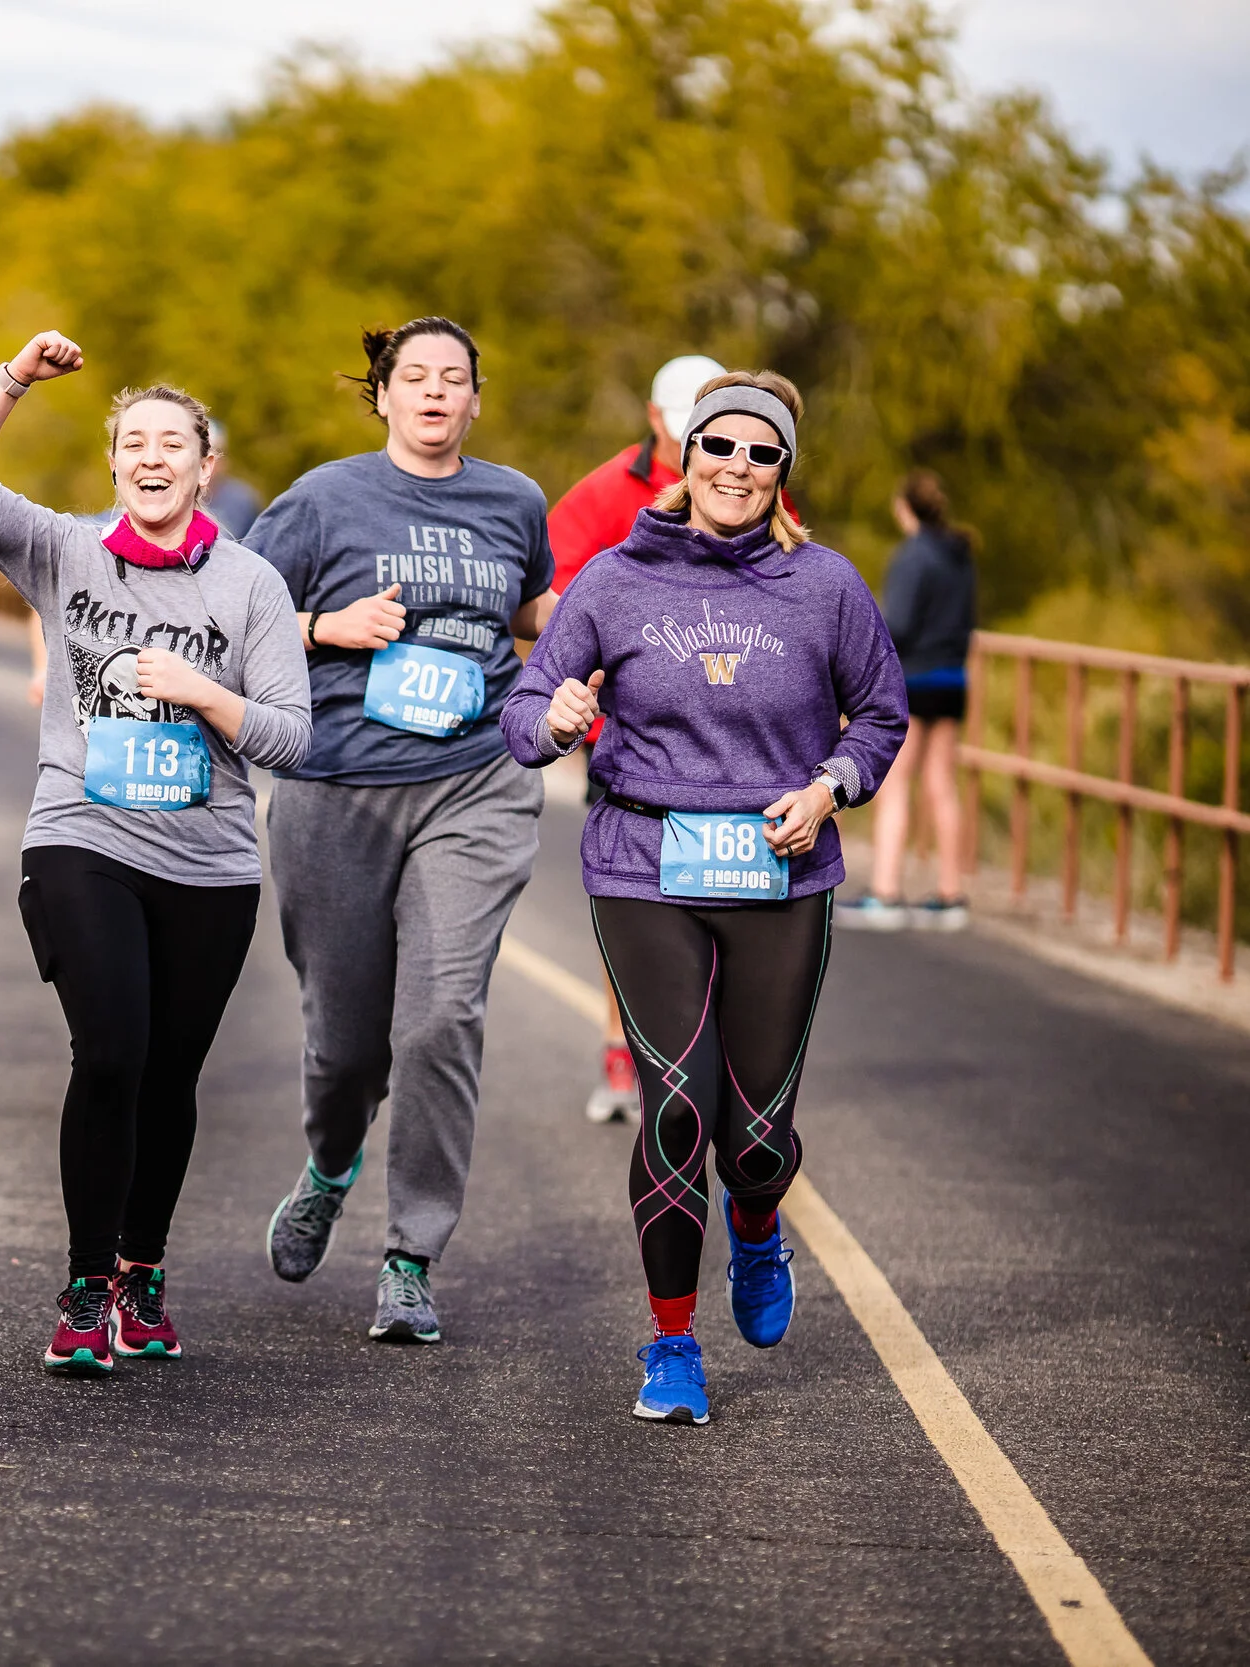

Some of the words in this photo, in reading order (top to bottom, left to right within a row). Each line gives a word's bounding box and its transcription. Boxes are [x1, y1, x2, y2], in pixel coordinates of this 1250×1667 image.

[408, 525, 474, 556] LET'S
[376, 554, 454, 585] FINISH
[459, 558, 508, 593] THIS
[411, 585, 442, 603] YEAR
[461, 587, 484, 608] NEW
[433, 617, 466, 638] NOG
[462, 622, 496, 652] JOG
[642, 598, 784, 664] Washington
[399, 660, 458, 704] 207
[699, 653, 741, 685] W
[414, 706, 439, 723] NOG
[123, 737, 180, 777] 113
[137, 783, 163, 798] NOG
[159, 785, 192, 802] JOG
[698, 822, 756, 862] 168
[714, 869, 741, 884] NOG
[739, 870, 771, 889] JOG
